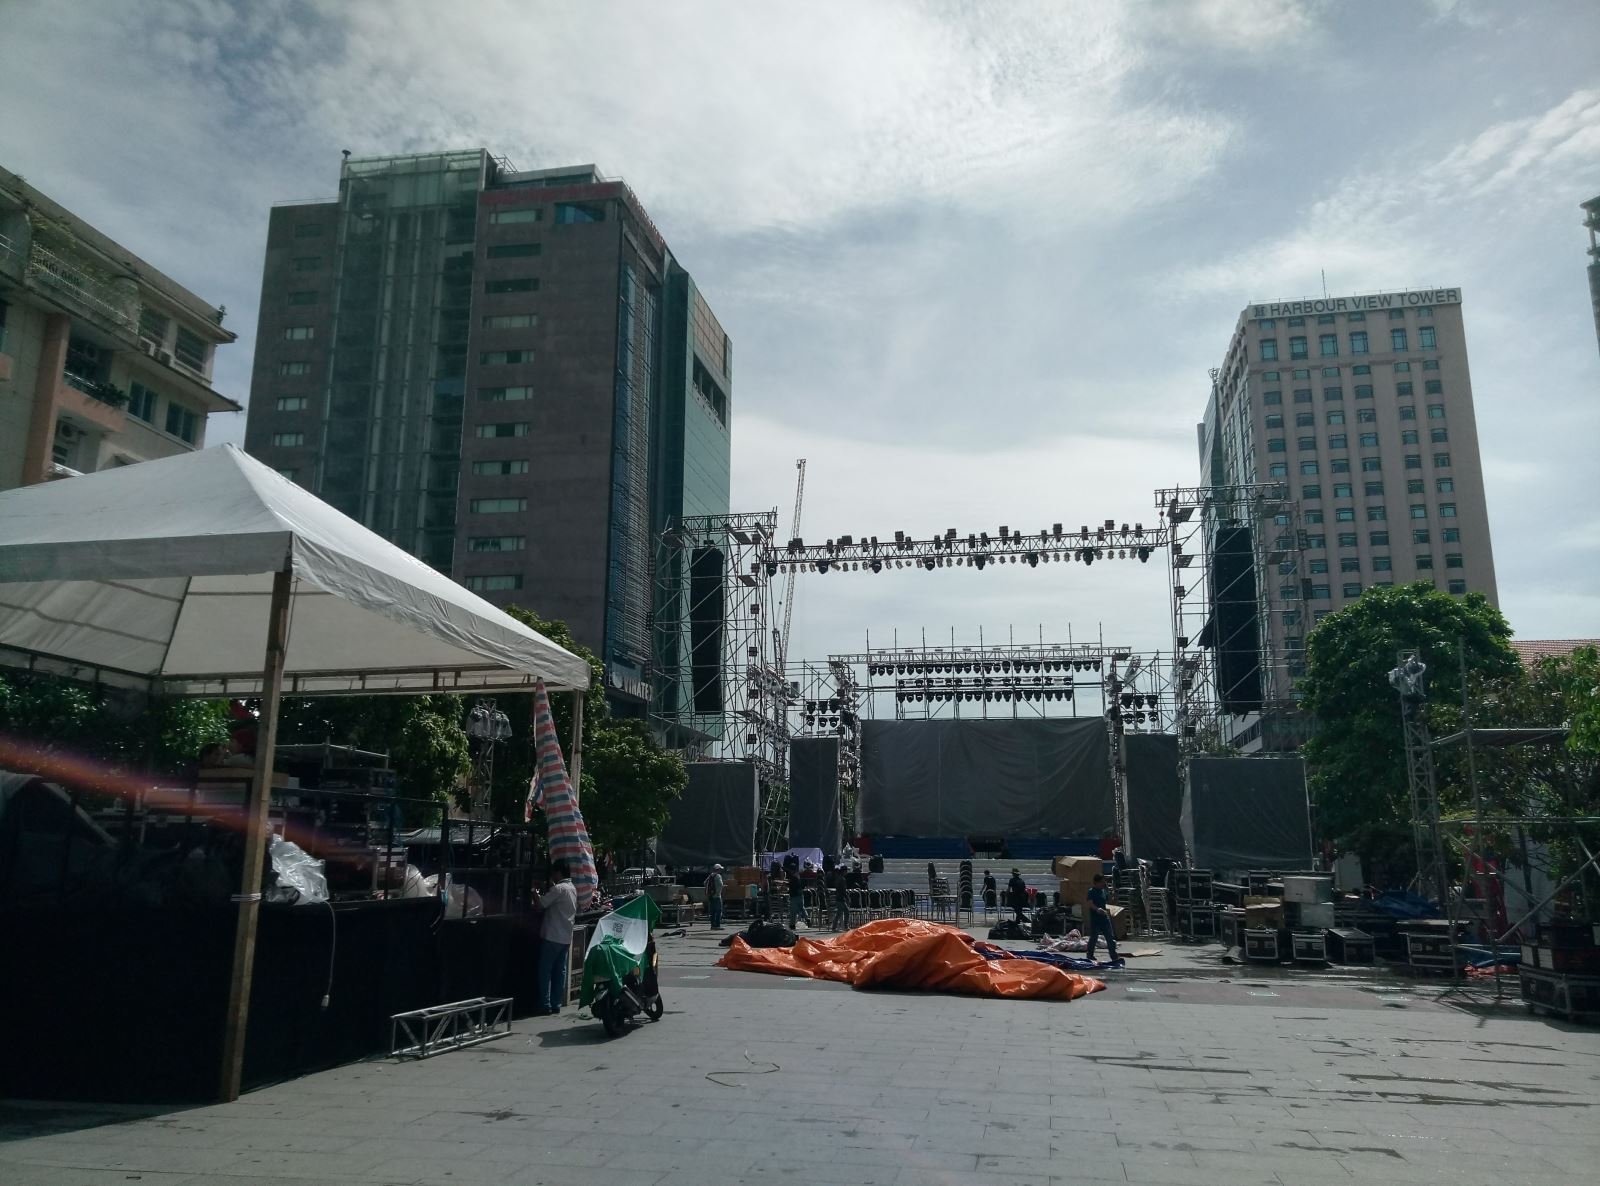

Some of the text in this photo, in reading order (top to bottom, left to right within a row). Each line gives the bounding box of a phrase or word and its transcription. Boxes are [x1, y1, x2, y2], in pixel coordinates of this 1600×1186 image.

[1271, 289, 1458, 316] HARBOUR VIEW TOWER
